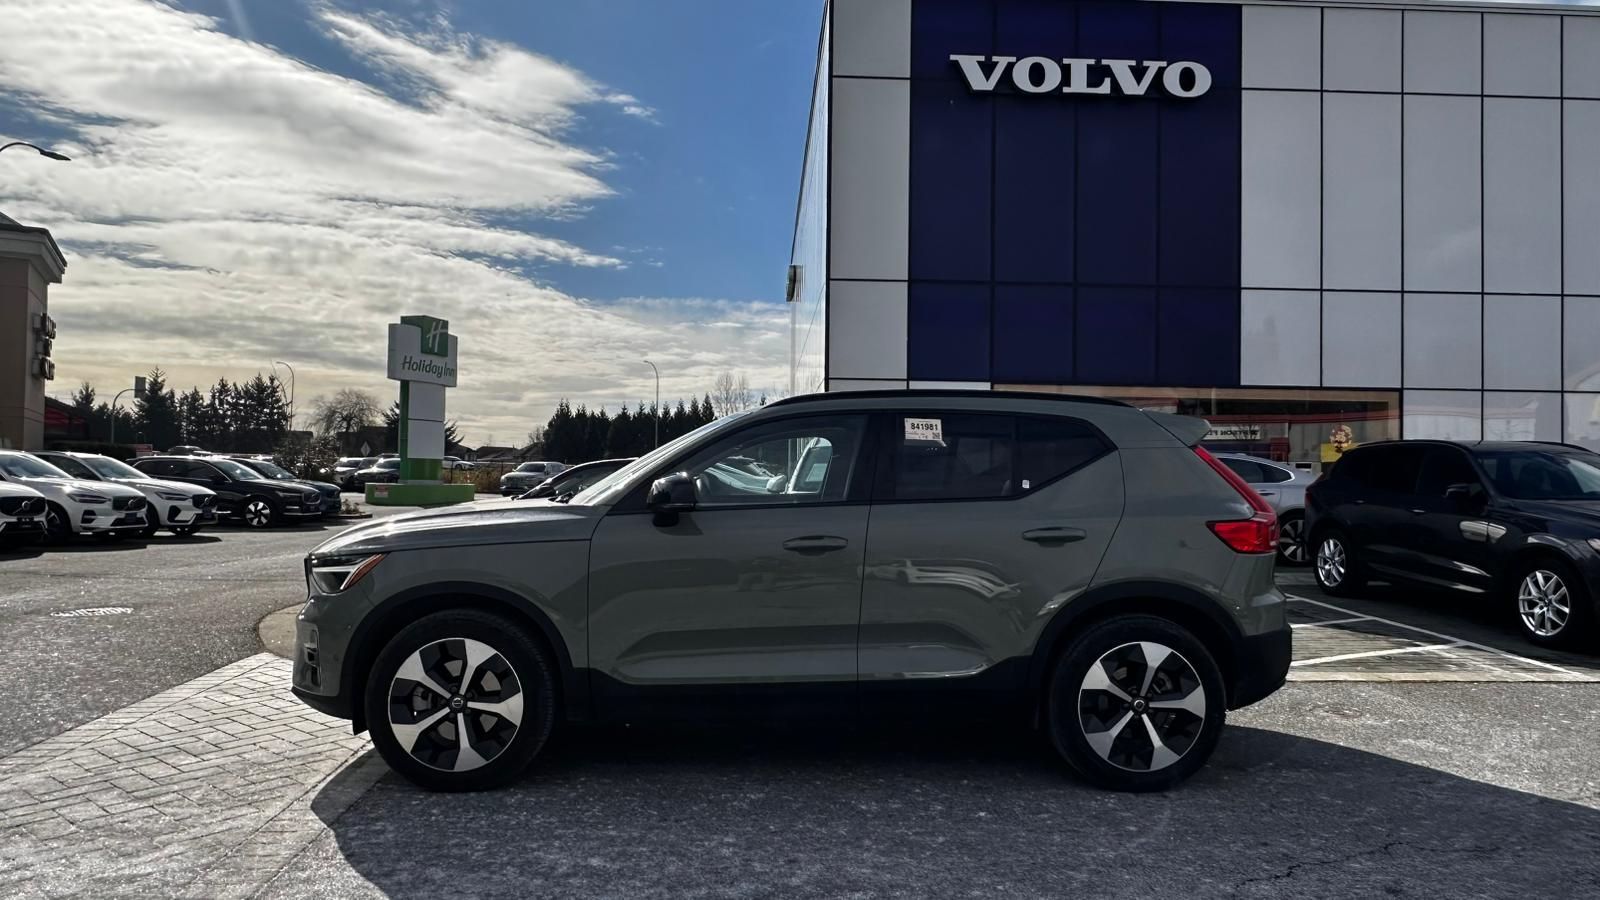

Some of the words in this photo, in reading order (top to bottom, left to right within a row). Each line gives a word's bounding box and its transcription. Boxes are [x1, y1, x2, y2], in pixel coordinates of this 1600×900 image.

[950, 54, 1212, 98] VOLVO
[402, 355, 443, 378] Holiday
[444, 361, 455, 377] Inn
[911, 422, 938, 431] 841981
